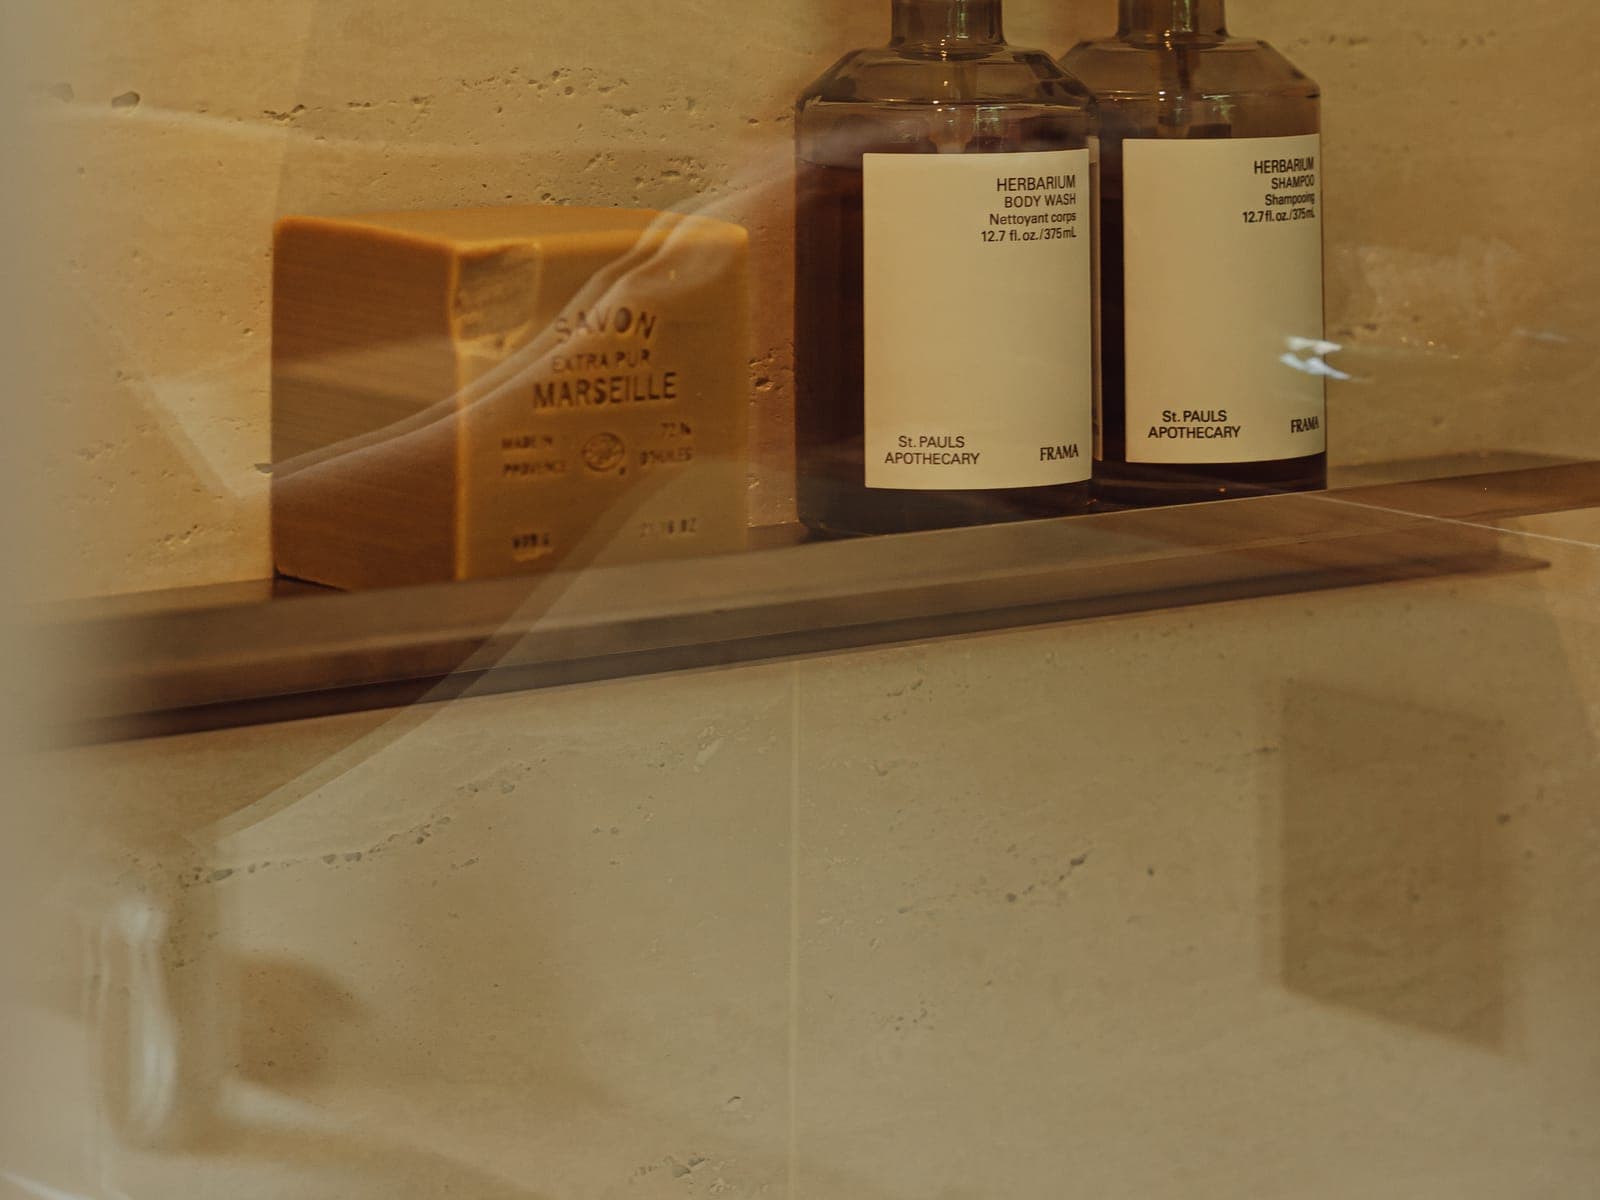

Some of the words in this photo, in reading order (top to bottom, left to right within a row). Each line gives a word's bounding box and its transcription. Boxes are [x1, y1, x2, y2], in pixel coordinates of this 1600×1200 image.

[1254, 157, 1314, 174] HERBARIUM
[997, 174, 1076, 191] HERBARIUM
[1271, 174, 1315, 189] SHAMPOO
[1004, 195, 1041, 208] BODY
[1044, 193, 1076, 206] WASH
[1265, 193, 1315, 206] Shampooing
[989, 213, 1048, 227] Nettoyant
[1051, 212, 1076, 224] corps
[1242, 210, 1264, 223] 12.7
[981, 230, 1006, 242] 12.7
[555, 307, 656, 346] SAVON
[552, 353, 608, 373] EXTRA
[615, 349, 650, 369] PUR
[533, 372, 677, 408] MARSEILLE
[1162, 410, 1180, 423] St.
[1183, 410, 1228, 423] PAULS
[1290, 416, 1320, 433] FRAMA
[1148, 426, 1241, 439] APOTHECARY
[898, 435, 916, 448] St.
[919, 435, 965, 448] PAULS
[884, 452, 980, 465] APOTHECARY
[1039, 444, 1079, 462] FRAMA
